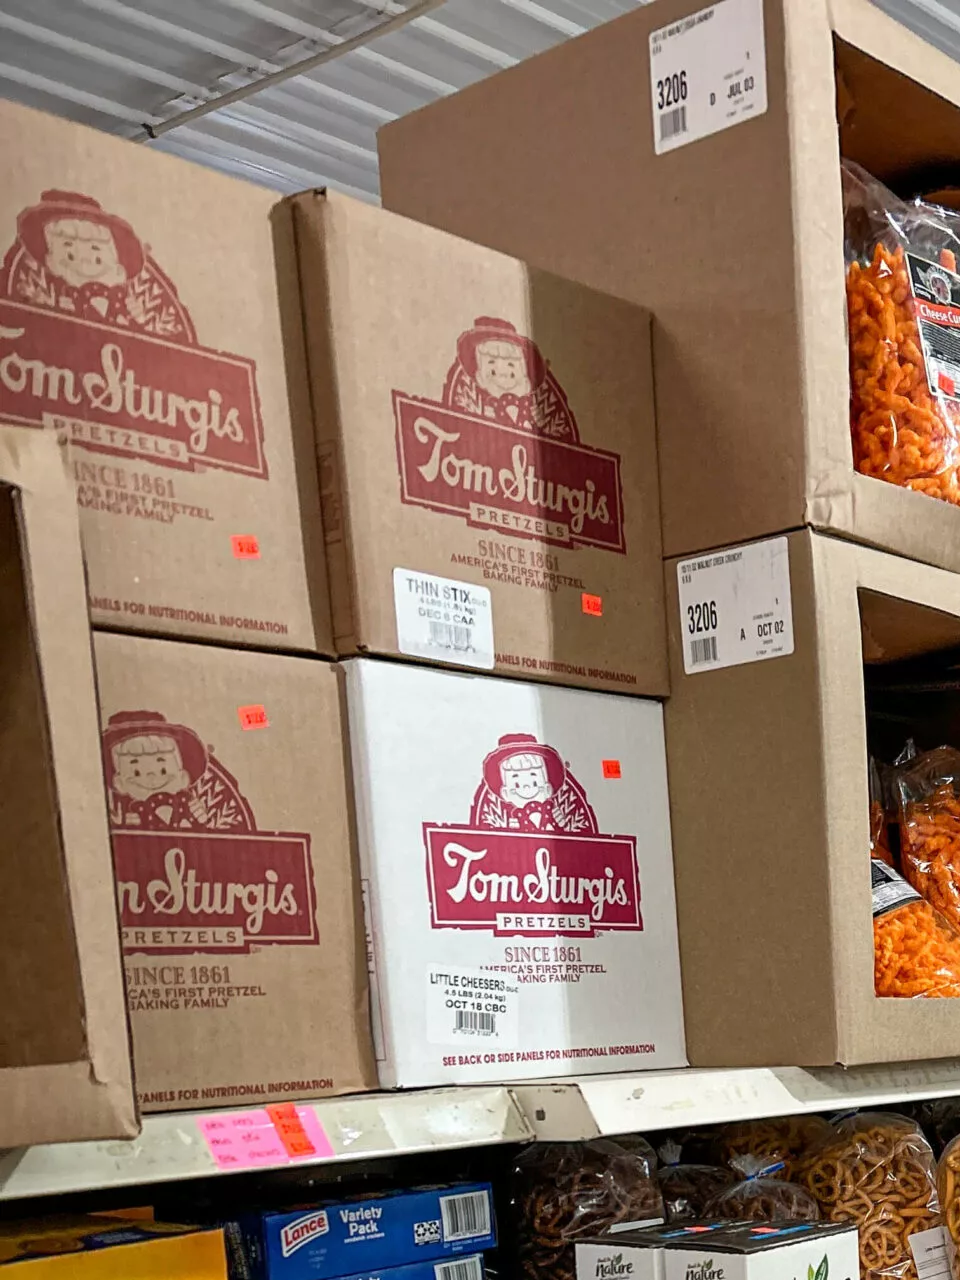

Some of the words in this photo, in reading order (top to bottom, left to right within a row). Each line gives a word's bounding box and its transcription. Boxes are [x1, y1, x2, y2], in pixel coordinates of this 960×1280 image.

[657, 70, 688, 110] 3206
[727, 82, 742, 99] JUL
[919, 306, 948, 322] Cheese
[83, 343, 245, 452] Sturgis
[133, 472, 177, 499] 1861
[413, 416, 497, 496] Tom
[498, 444, 610, 533] Sturgis
[151, 498, 214, 521] PRETZEL
[475, 506, 566, 538] PRETZELS
[478, 538, 526, 565] SINCE
[530, 551, 560, 572] 1861
[450, 552, 509, 574] AMERICA'S
[511, 564, 540, 579] FIRST
[543, 570, 587, 591] PRETZEL
[482, 568, 524, 586] BAKING
[525, 576, 561, 594] FAMILY
[406, 577, 440, 599] THIN
[442, 585, 471, 604] STIX
[123, 601, 146, 616] FOR
[148, 604, 218, 627] NUTRITIONAL
[219, 614, 290, 636] INFORMATION
[688, 600, 718, 635] 3206
[757, 622, 773, 638] OCT
[774, 619, 785, 635] 02
[539, 658, 586, 678] NUTRITIONAL
[587, 665, 638, 685] INFORMATION
[146, 847, 298, 934] Sturgis
[443, 842, 524, 904] Tom
[522, 847, 629, 922] Sturgis
[503, 915, 587, 930] PRETZELS
[504, 946, 550, 963] SINCE
[553, 946, 583, 963] 1861
[190, 965, 231, 985] 1861
[535, 964, 563, 974] FIRST
[565, 964, 607, 974] PRETZEL
[549, 974, 581, 984] FAMILY
[165, 986, 205, 999] FIRST
[207, 985, 267, 998] PRETZEL
[430, 973, 460, 987] LITTLE
[460, 975, 506, 992] CHEESERS
[183, 997, 230, 1009] FAMILY
[445, 999, 467, 1010] OCT
[442, 1056, 457, 1067] SEE
[458, 1053, 482, 1065] BACK
[483, 1052, 496, 1063] OR
[497, 1051, 514, 1063] SIDE
[516, 1049, 545, 1062] PANELS
[545, 1048, 560, 1060] FOR
[561, 1046, 608, 1059] NUTRITIONAL
[608, 1043, 656, 1057] INFORMATION
[177, 1089, 199, 1102] FOR
[200, 1083, 267, 1100] NUTRITIONAL
[267, 1078, 334, 1094] INFORMATION
[340, 1206, 383, 1224] Variety
[283, 1214, 327, 1248] Lance
[349, 1220, 379, 1236] Pack
